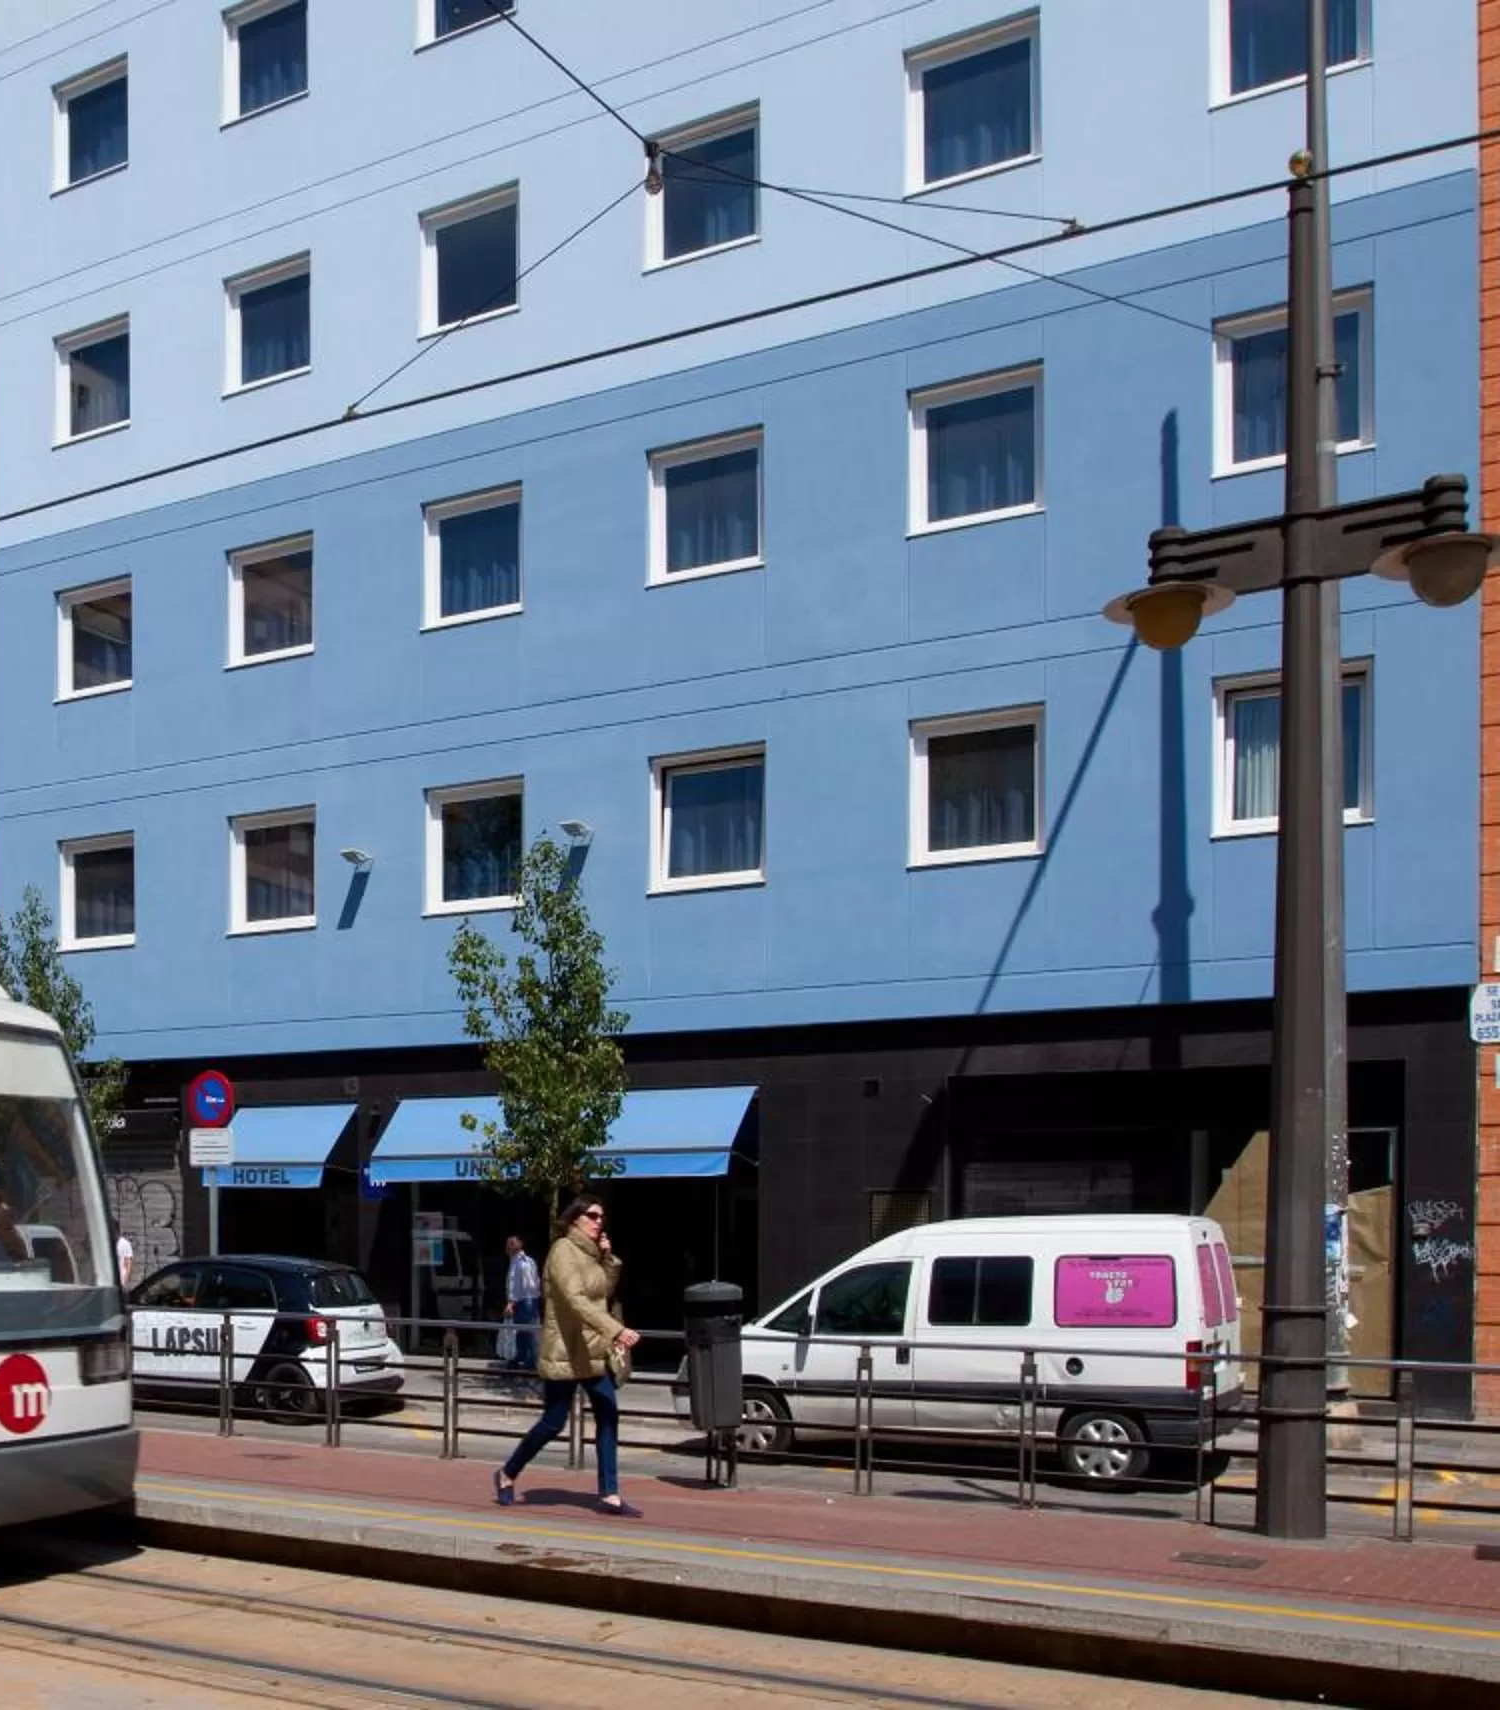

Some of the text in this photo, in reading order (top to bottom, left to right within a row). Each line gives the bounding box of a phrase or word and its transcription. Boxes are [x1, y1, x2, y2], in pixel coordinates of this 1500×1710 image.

[233, 1167, 291, 1185] HOTEL
[151, 1326, 232, 1357] LAPSU
[11, 1381, 51, 1419] m
